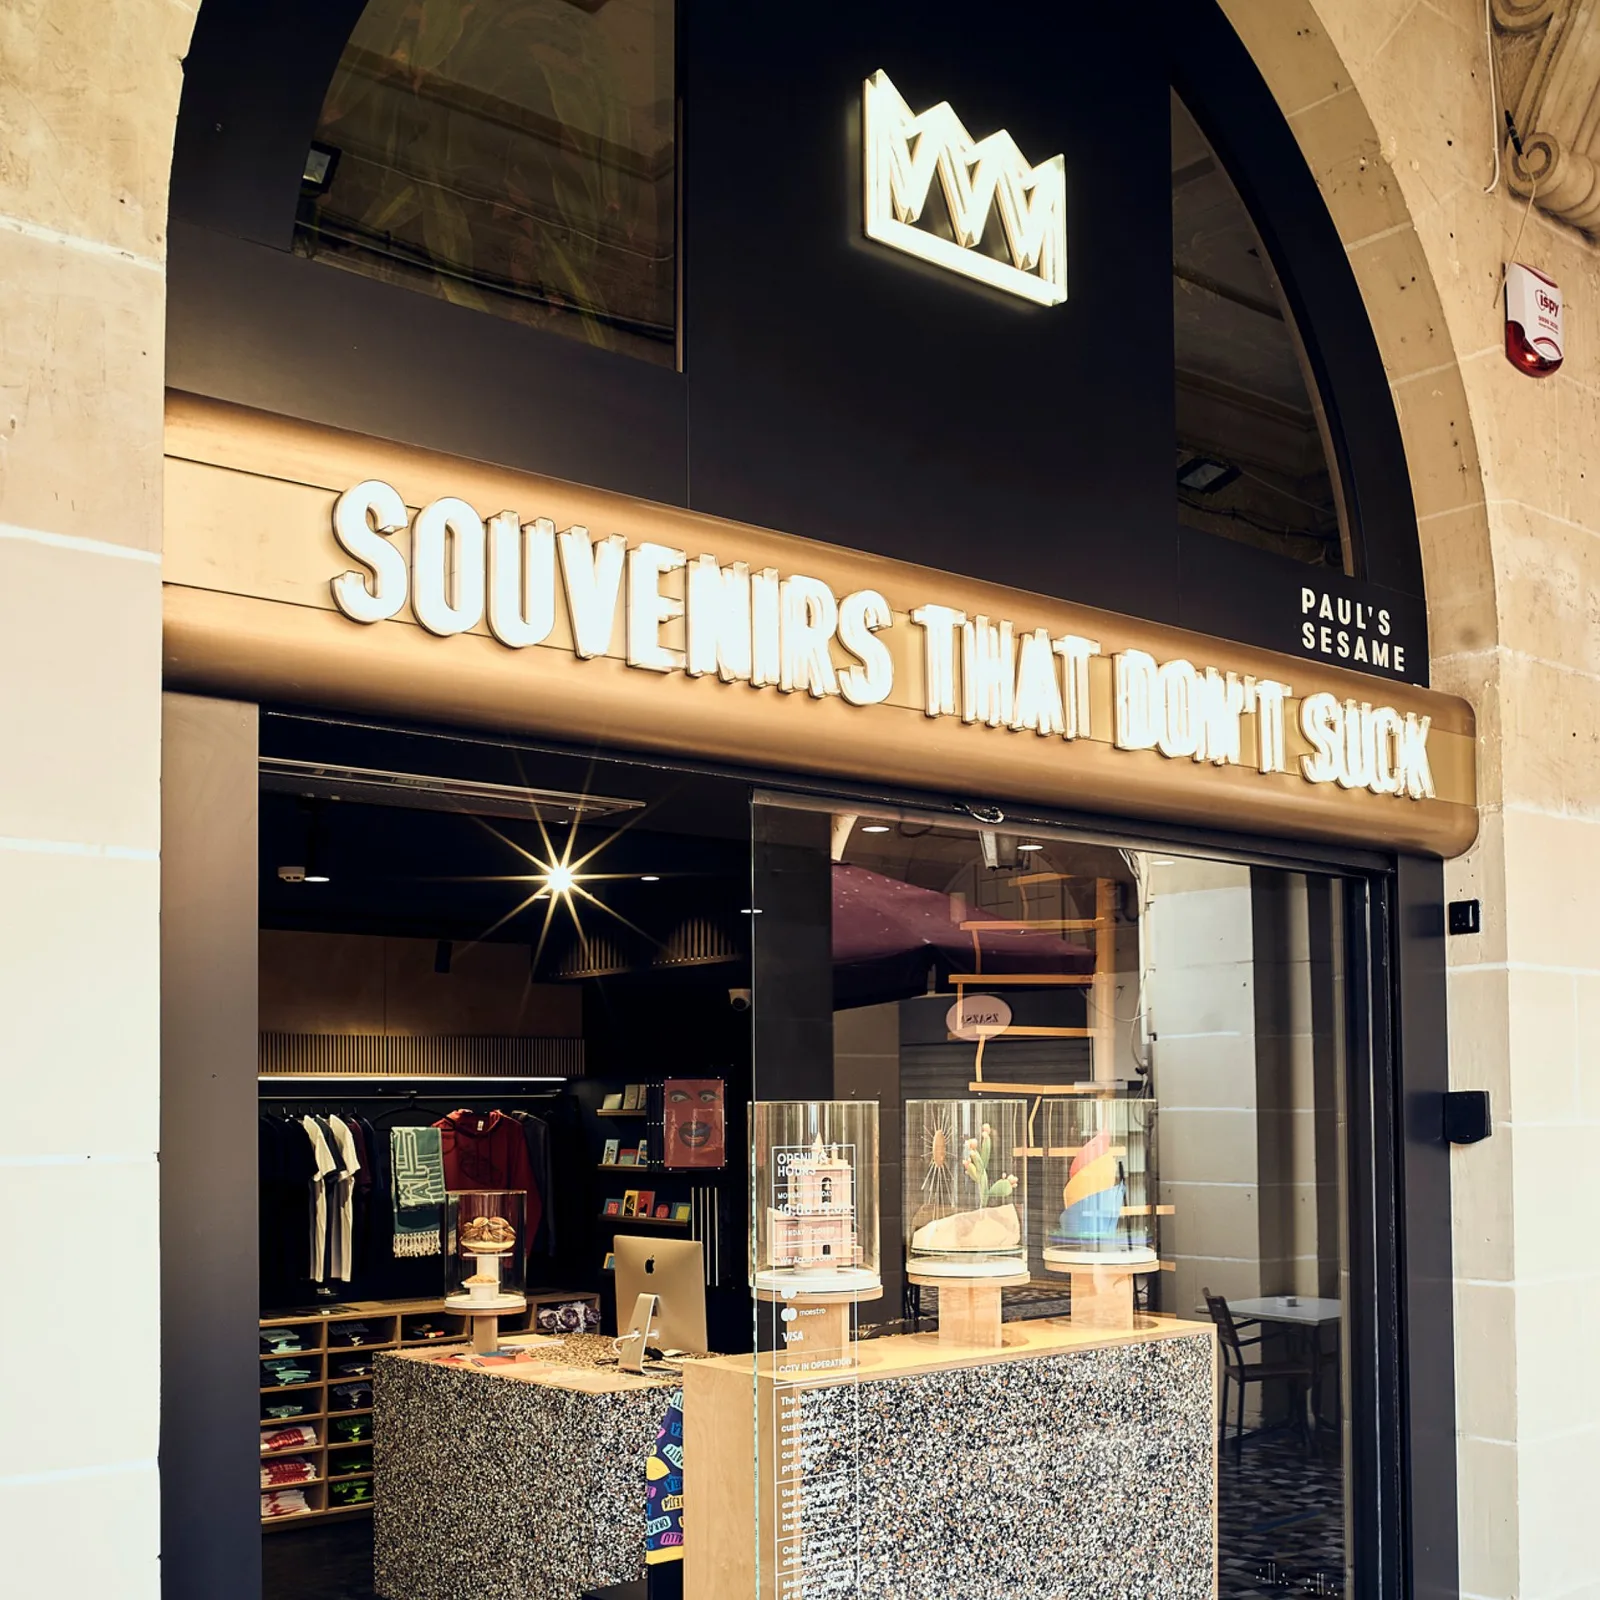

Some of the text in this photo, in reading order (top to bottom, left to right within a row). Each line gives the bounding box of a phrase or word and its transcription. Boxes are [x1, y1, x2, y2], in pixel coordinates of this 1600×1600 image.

[1301, 586, 1392, 637] PAUL'S
[330, 479, 1436, 801] SOUVENIRS THAT DON'T SUCK
[1301, 621, 1405, 673] SESAME
[781, 1331, 804, 1343] VISA
[801, 1361, 810, 1371] IN
[782, 1396, 796, 1405] The
